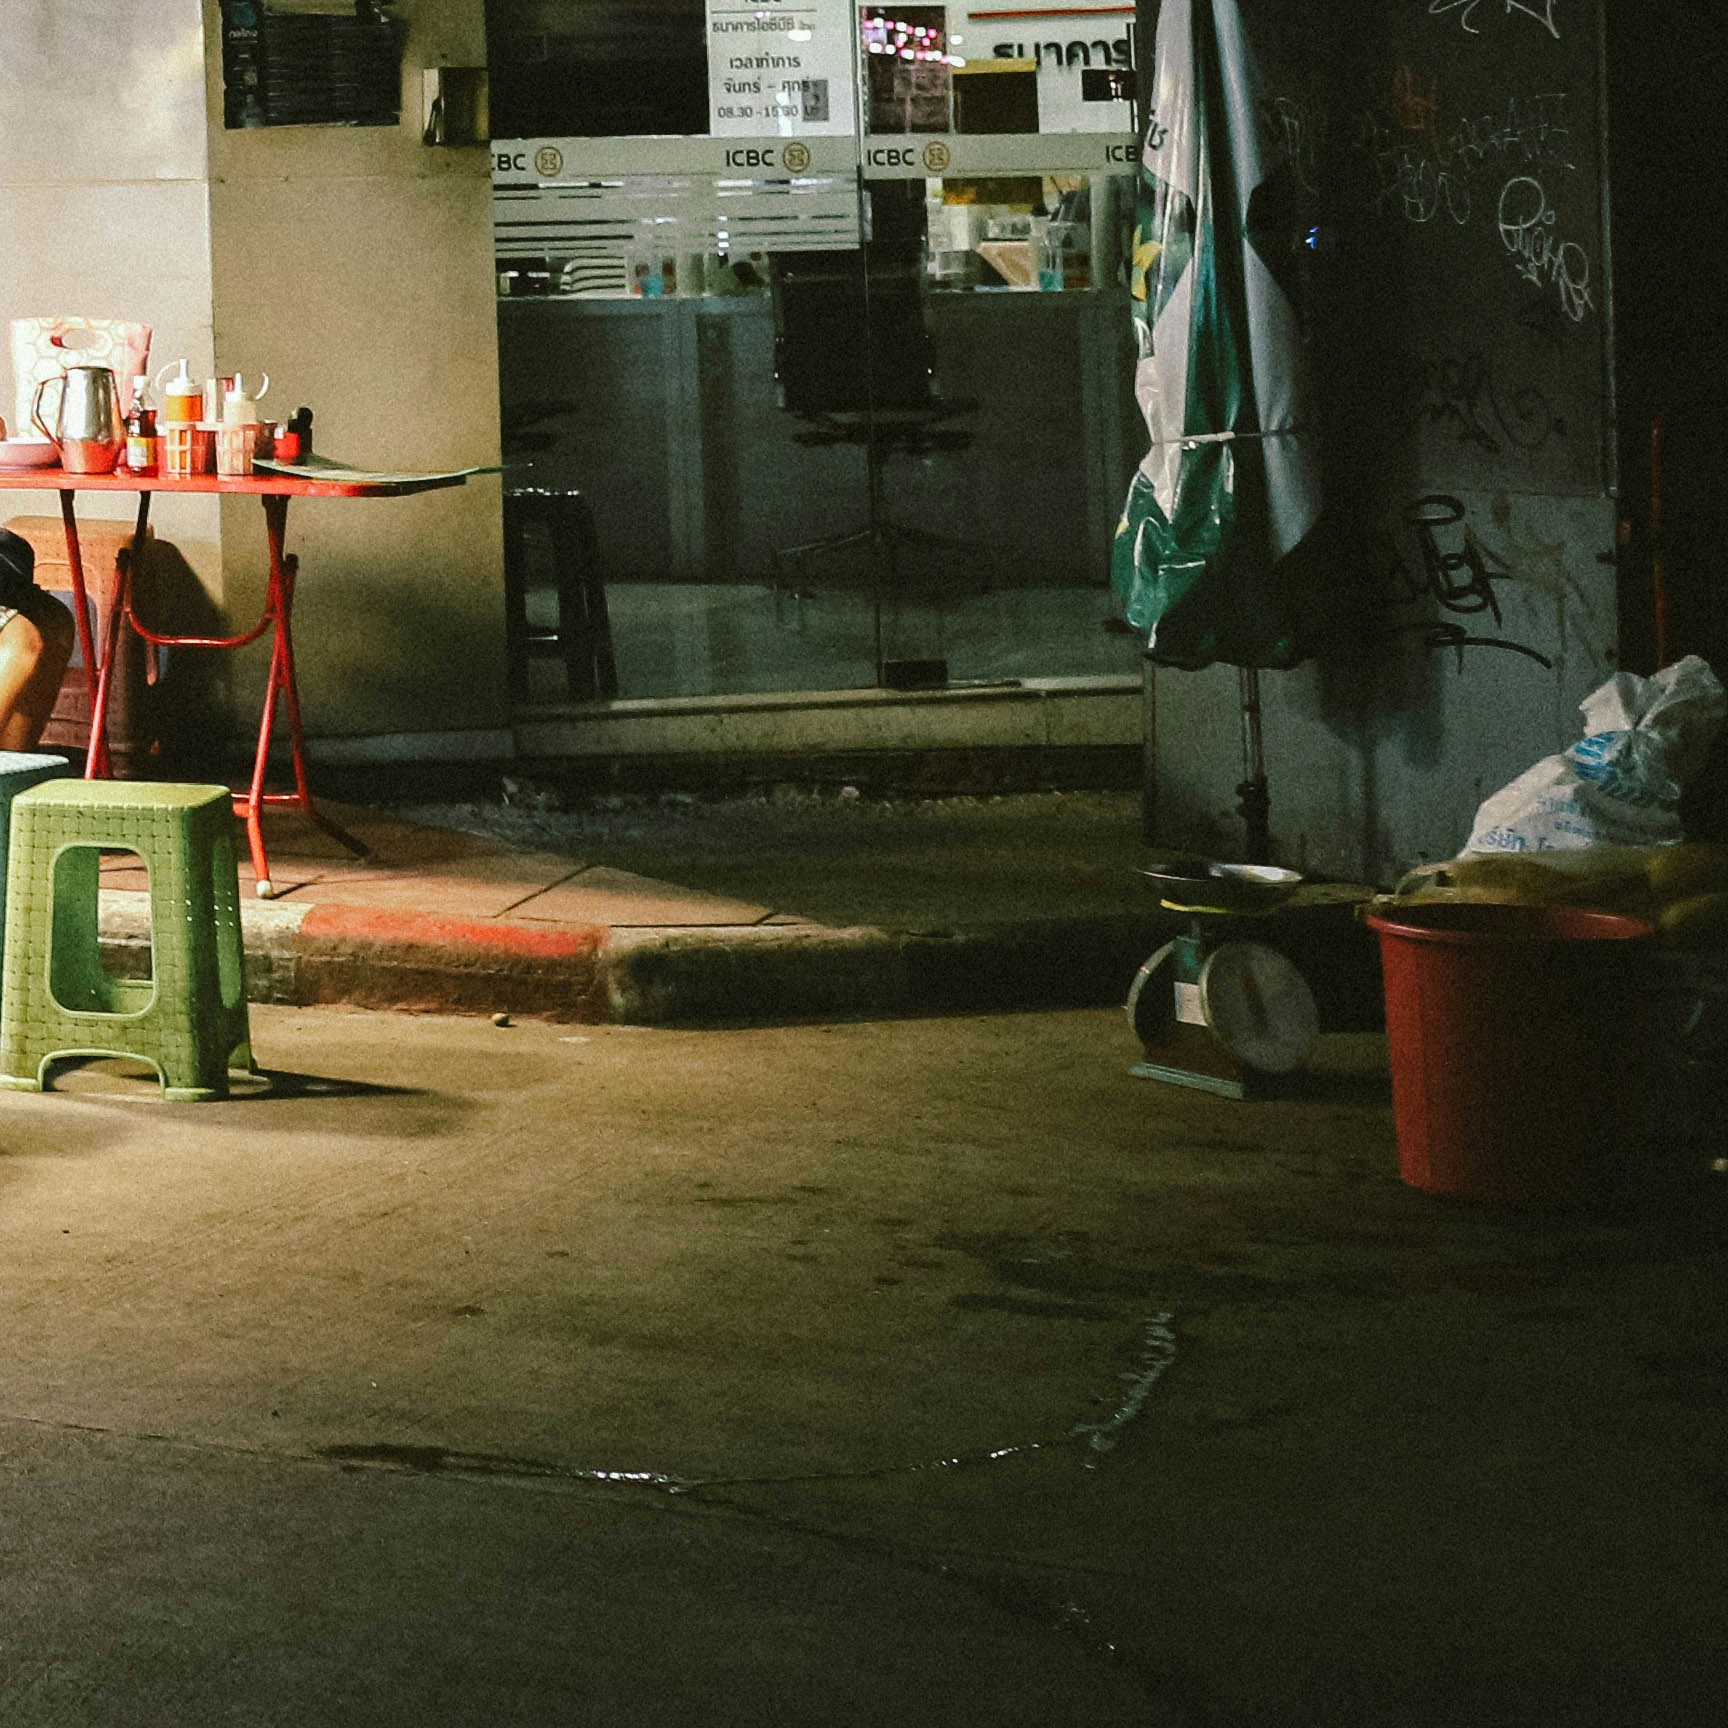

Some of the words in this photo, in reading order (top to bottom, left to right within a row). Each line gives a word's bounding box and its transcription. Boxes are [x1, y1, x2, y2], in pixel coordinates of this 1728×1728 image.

[729, 51, 801, 69] เวลาทำการ
[717, 106, 753, 119] 08.30
[489, 153, 526, 171] BC
[725, 150, 775, 167] ICBC
[867, 148, 915, 167] ICBC
[1105, 146, 1138, 162] ICB
